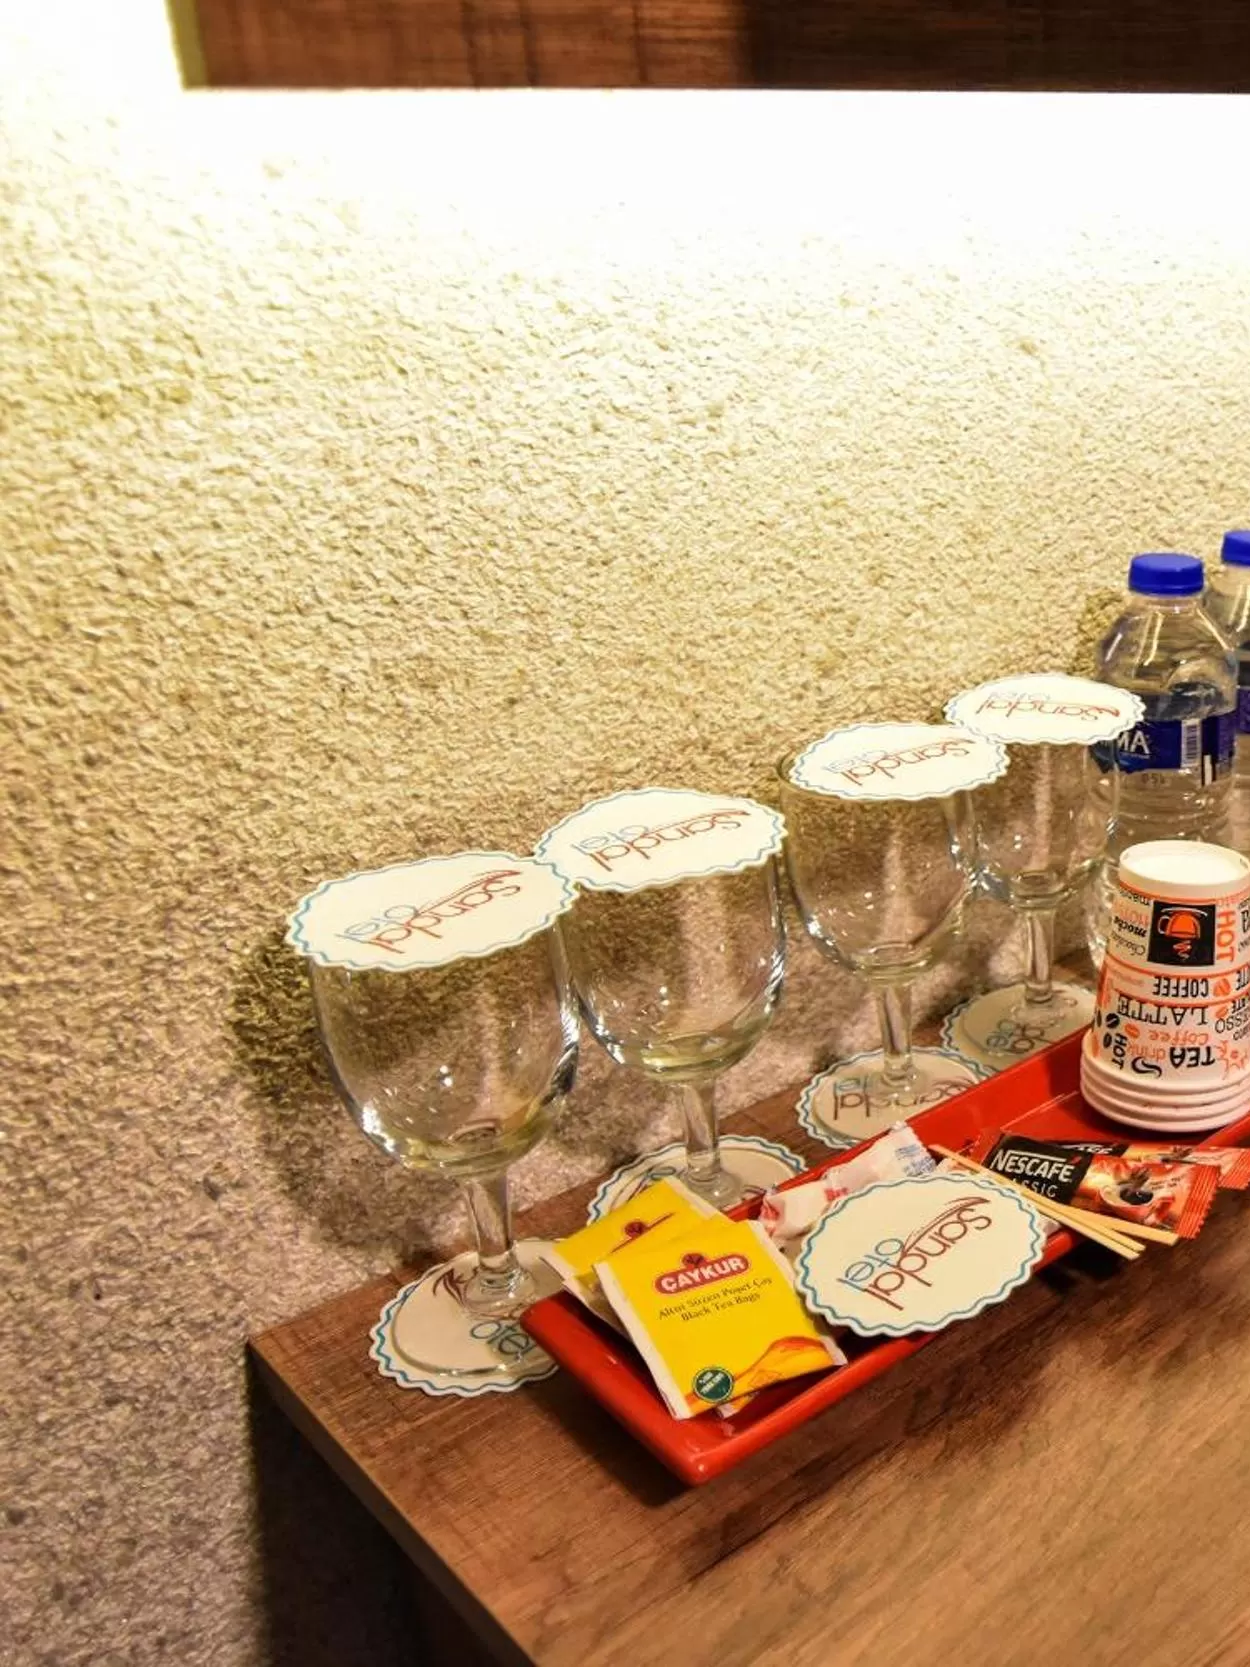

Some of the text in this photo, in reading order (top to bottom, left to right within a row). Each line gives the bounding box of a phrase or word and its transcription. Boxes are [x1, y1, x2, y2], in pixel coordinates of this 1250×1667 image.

[841, 738, 972, 786] Sandal
[590, 811, 747, 872] Sandal
[366, 872, 523, 954] Sandal
[1216, 910, 1236, 963] HOT
[1117, 994, 1209, 1026] LATTE
[1152, 976, 1209, 997] COFFEE
[1112, 1033, 1128, 1070] HOT
[1170, 1046, 1216, 1069] TEA
[661, 1257, 746, 1292] ÇAYKUR
[838, 1238, 904, 1292] otel
[865, 1197, 992, 1311] Sandal
